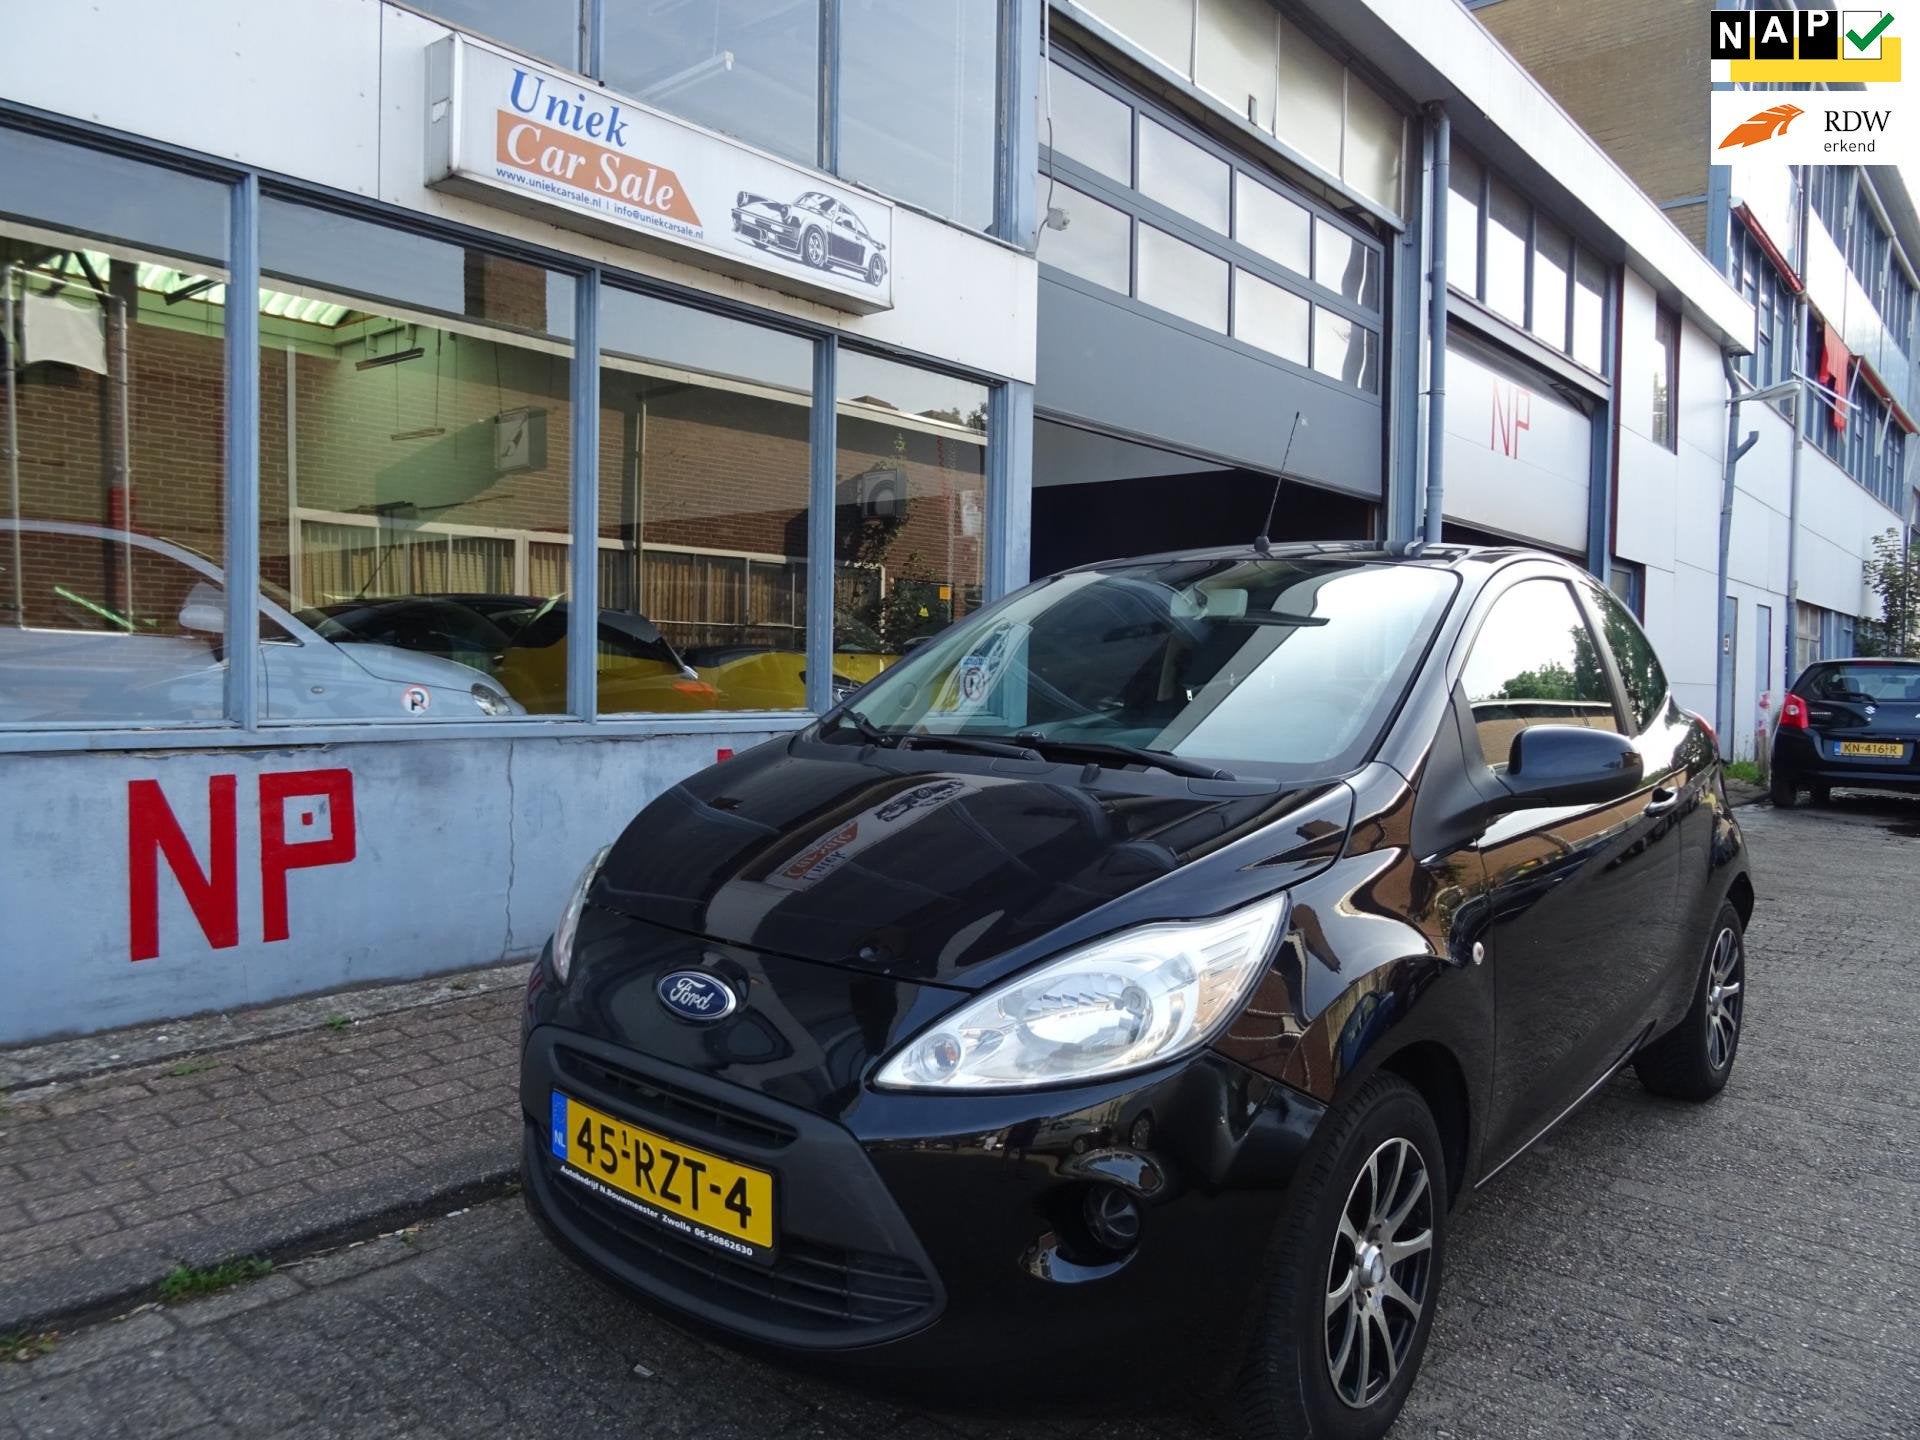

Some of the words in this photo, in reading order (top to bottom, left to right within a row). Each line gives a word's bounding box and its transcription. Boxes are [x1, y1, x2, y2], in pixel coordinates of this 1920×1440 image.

[510, 68, 629, 147] Uniek
[496, 168, 601, 208] www.uniekcarsale.nl
[614, 203, 704, 240] info@uniekcarsale.nl
[507, 123, 586, 179] Car
[595, 153, 674, 211] Sale
[1491, 379, 1530, 459] NP
[129, 768, 356, 962] NP
[669, 977, 714, 1011] Ford
[560, 1165, 599, 1190] Autobedrijf
[662, 1214, 691, 1232] Zwolle
